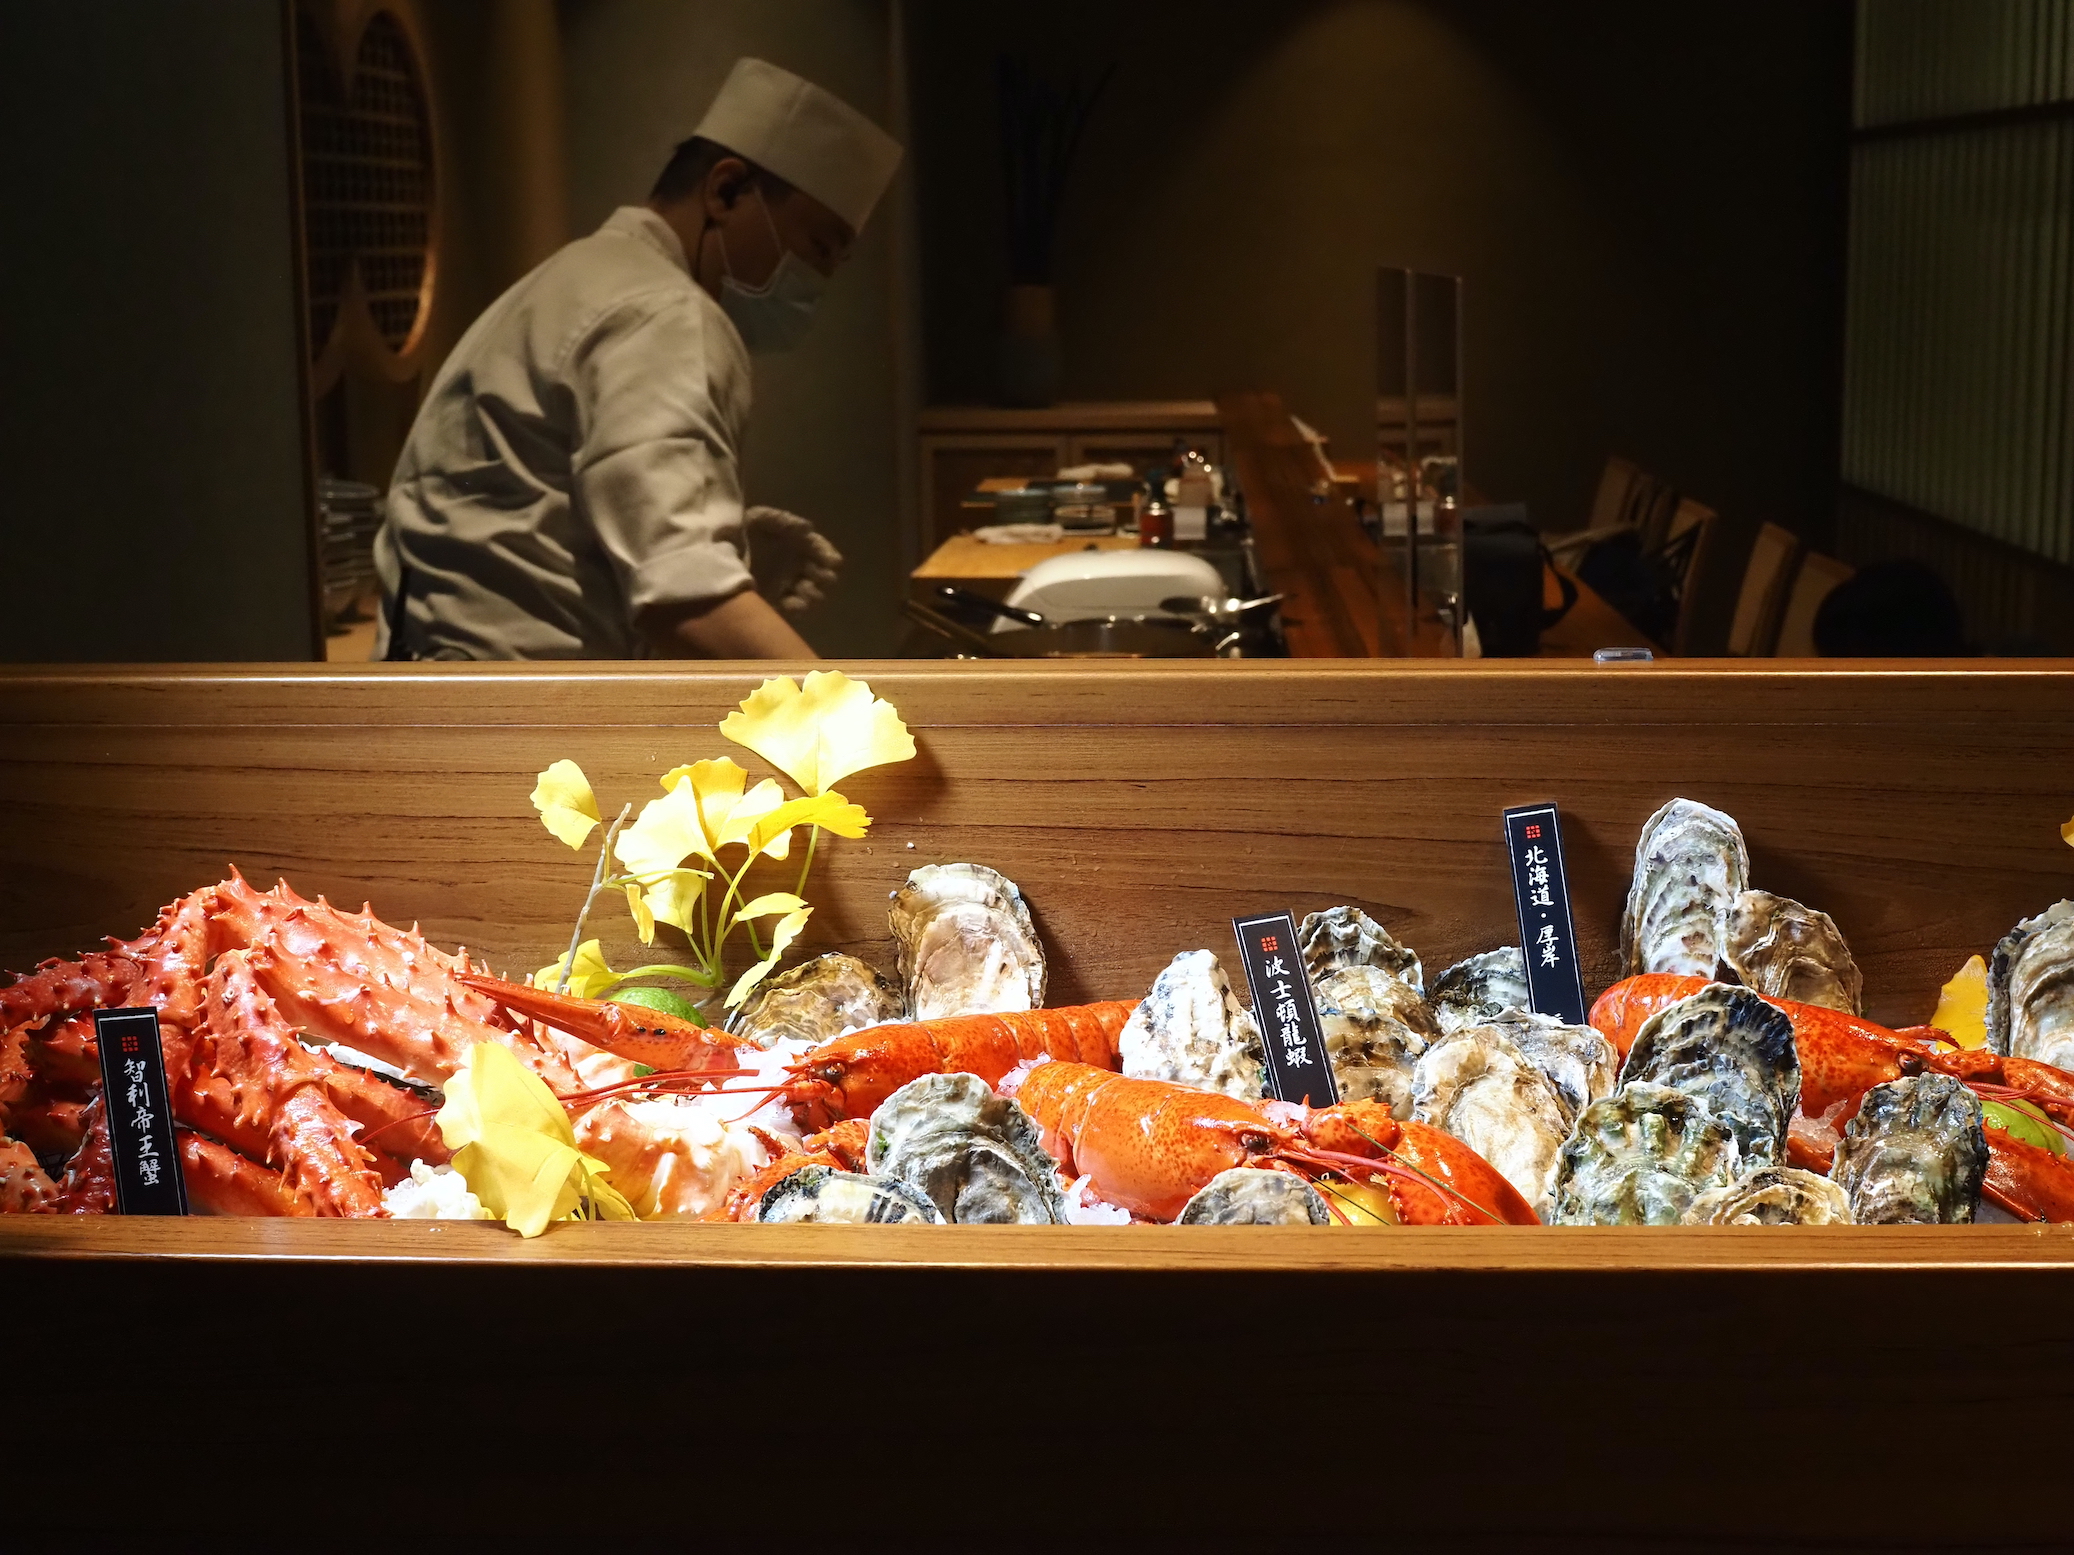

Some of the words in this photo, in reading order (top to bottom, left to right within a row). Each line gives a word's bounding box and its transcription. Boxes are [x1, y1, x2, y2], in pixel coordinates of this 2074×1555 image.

[1265, 956, 1313, 1068] 波士頓龍蝦
[123, 1058, 161, 1186] 智利帝王蟹
